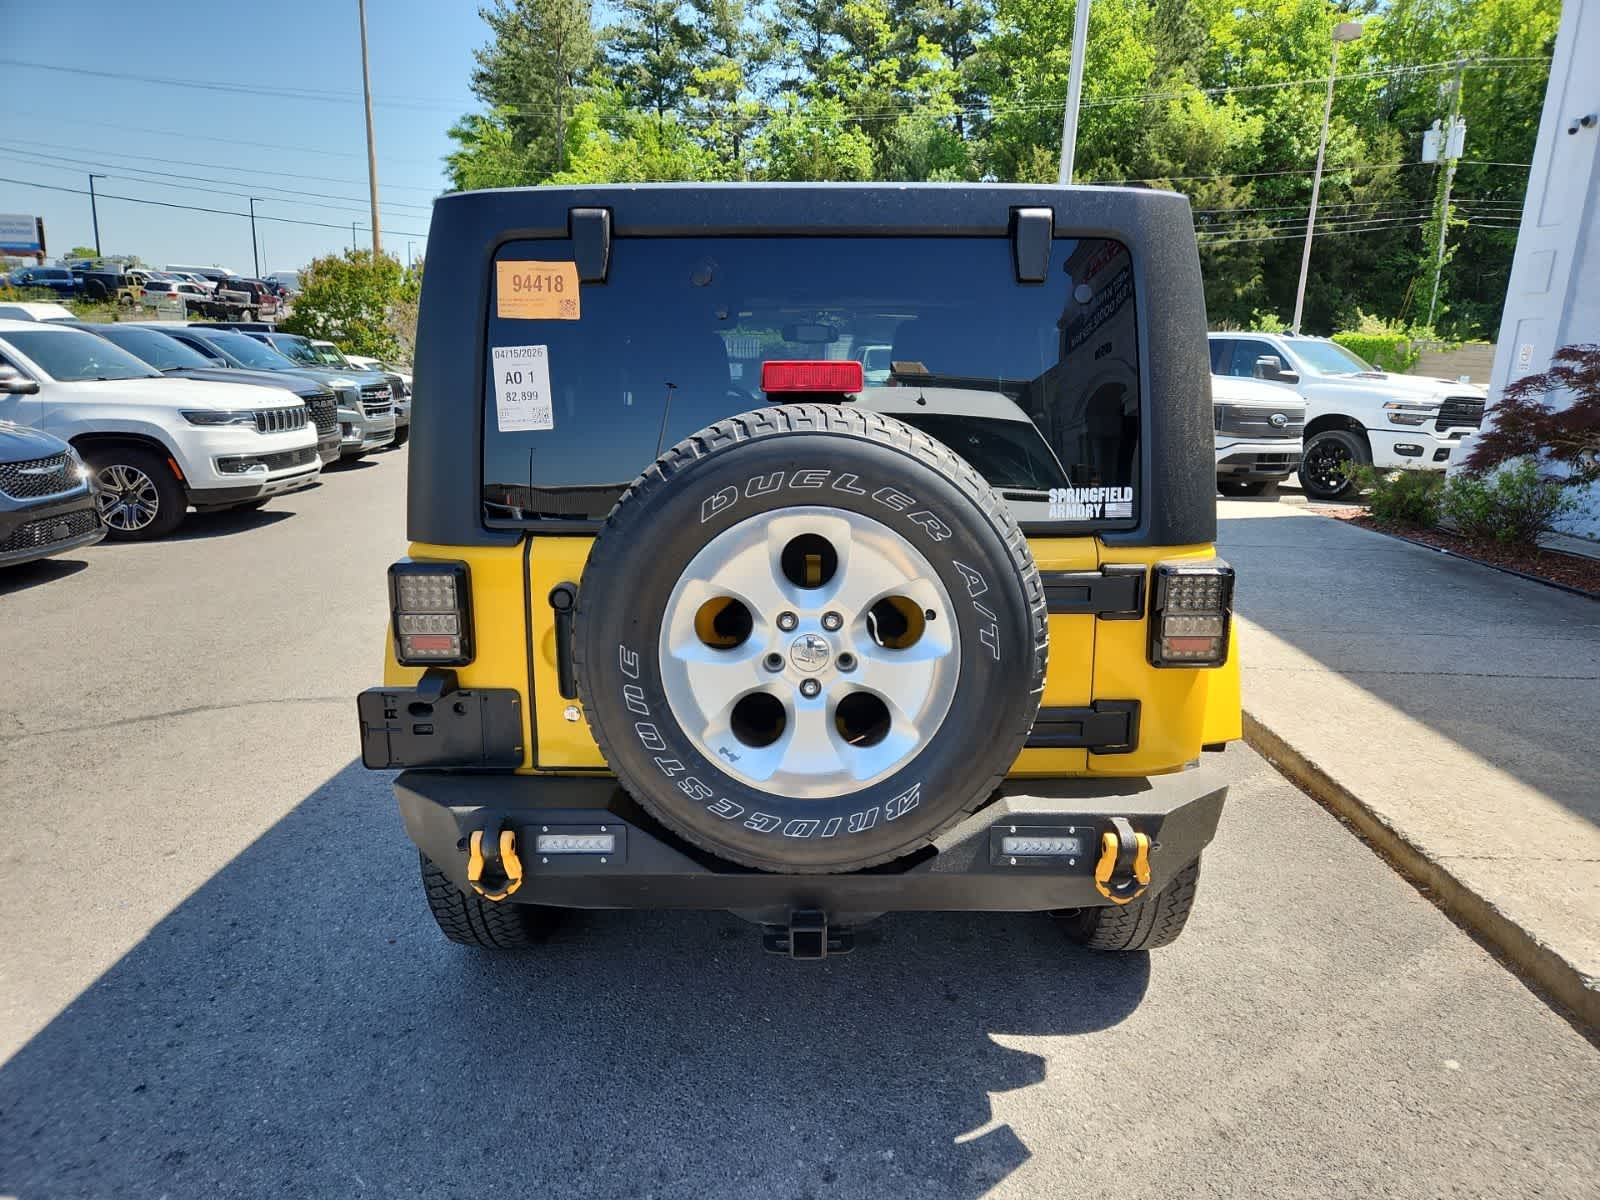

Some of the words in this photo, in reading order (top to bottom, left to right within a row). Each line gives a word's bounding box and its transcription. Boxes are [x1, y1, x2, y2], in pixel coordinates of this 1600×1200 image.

[512, 274, 564, 292] 94418
[494, 348, 542, 359] 04/15/2026
[528, 371, 534, 384] 1
[505, 391, 538, 402] 82,899
[1048, 487, 1133, 503] SPRINGFIELD
[1048, 503, 1102, 518] ARMORY
[701, 469, 953, 542] DUELER
[953, 560, 1001, 661] A/T
[619, 645, 922, 838] BRIDGESTONE
